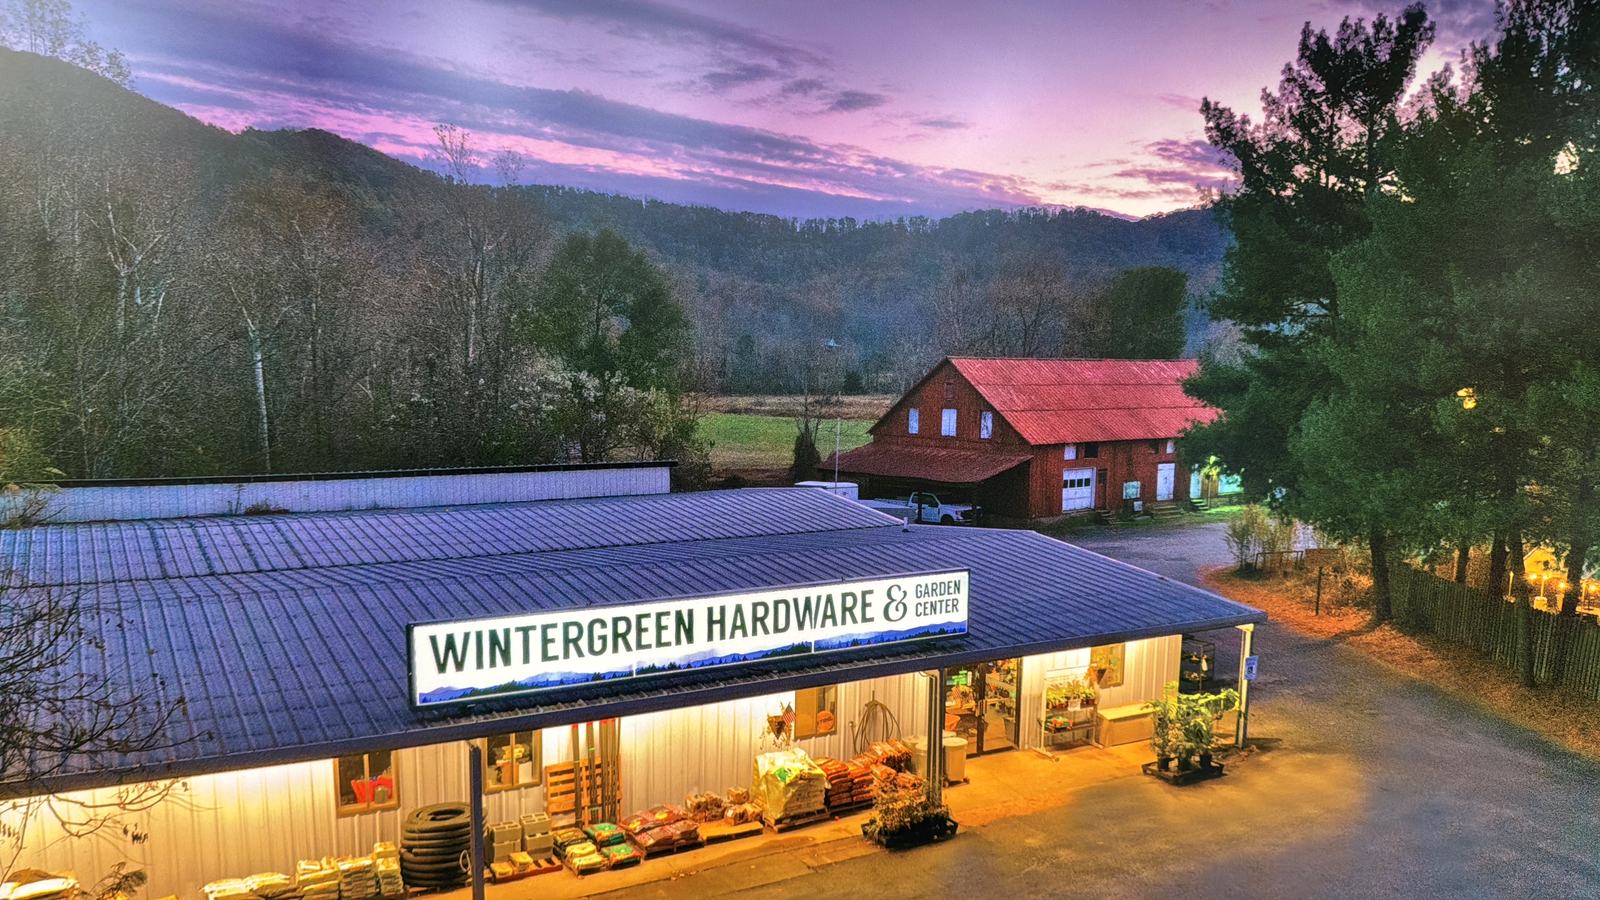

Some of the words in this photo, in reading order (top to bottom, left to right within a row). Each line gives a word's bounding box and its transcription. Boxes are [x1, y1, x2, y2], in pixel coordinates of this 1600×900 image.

[915, 579, 961, 599] GARDEN
[915, 598, 960, 617] CENTER
[429, 609, 694, 674] WINTERGREEN
[707, 589, 875, 642] HARDWARE
[883, 584, 908, 622] &
